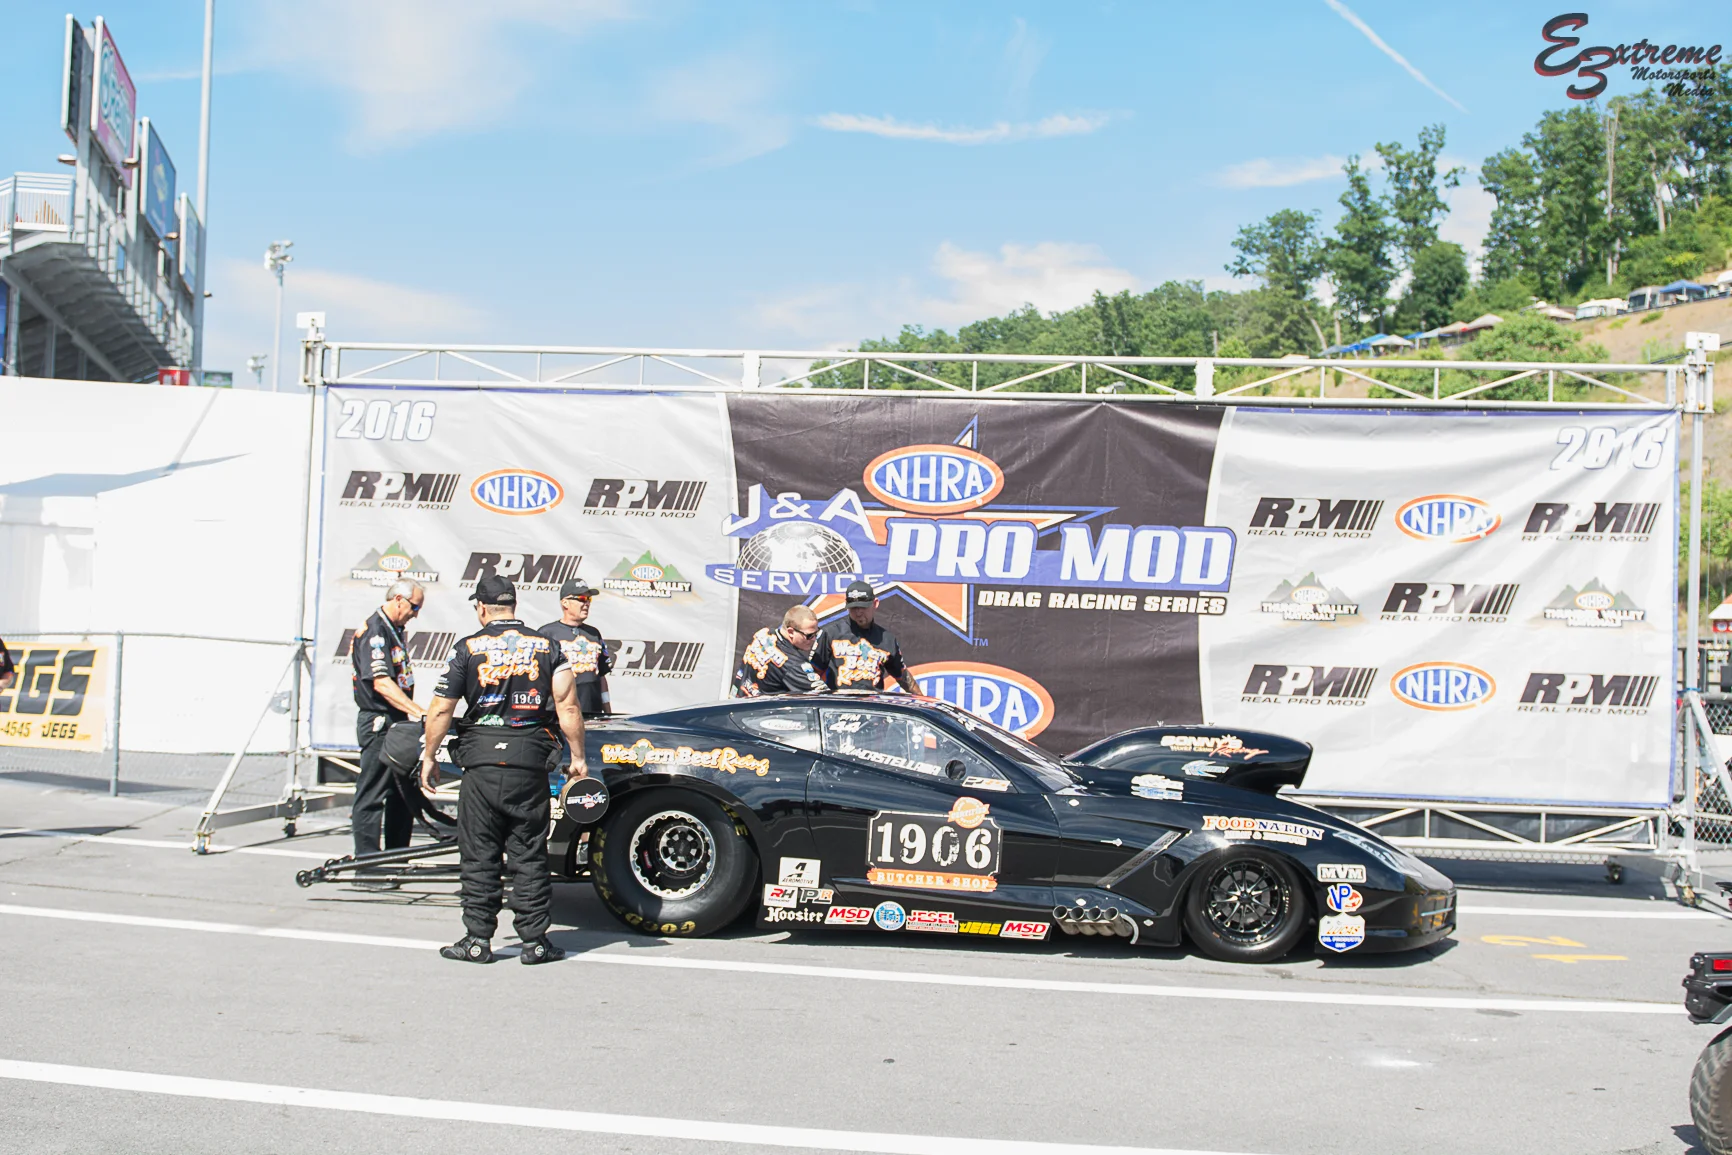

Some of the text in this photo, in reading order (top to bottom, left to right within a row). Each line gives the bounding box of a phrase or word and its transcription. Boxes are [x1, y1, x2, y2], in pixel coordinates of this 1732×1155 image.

[336, 399, 437, 441] 2016
[1550, 425, 1668, 470] 2016
[342, 471, 436, 502] RPM
[484, 476, 552, 508] NHRA
[886, 456, 984, 501] NHRA
[584, 479, 683, 511] RPM
[583, 509, 618, 517] REAL
[722, 484, 877, 544] J&A
[1249, 497, 1357, 529] RPM
[1411, 501, 1488, 535] NHRA
[1524, 502, 1632, 532] RPM
[461, 552, 557, 584] RPM
[887, 523, 1233, 585] PRO MOD
[604, 579, 691, 592] THUNDER VALLEY
[634, 566, 661, 579] NHRA
[714, 569, 885, 594] SERVICE
[978, 590, 1226, 614] DRAG RACING SERIES
[1382, 583, 1491, 614] RPM
[973, 639, 989, 647] TM
[1243, 664, 1351, 697] RPM
[1406, 669, 1483, 704] NHRA
[1520, 673, 1631, 705] RPM
[920, 677, 1027, 733] RA
[1241, 696, 1281, 704] REAL
[829, 721, 861, 733] 44
[677, 746, 721, 767] Beef
[718, 748, 769, 775] Racing
[877, 822, 991, 869] 1906
[877, 872, 989, 890] BUTCHER SHOP
[1321, 866, 1363, 879] MVM
[770, 887, 795, 899] RH
[1330, 885, 1351, 910] VP
[764, 906, 823, 922] Hoosier
[829, 908, 870, 919] MSD
[908, 911, 954, 924] JESEL
[959, 921, 1002, 935] JEGS
[1005, 922, 1047, 934] MSD
